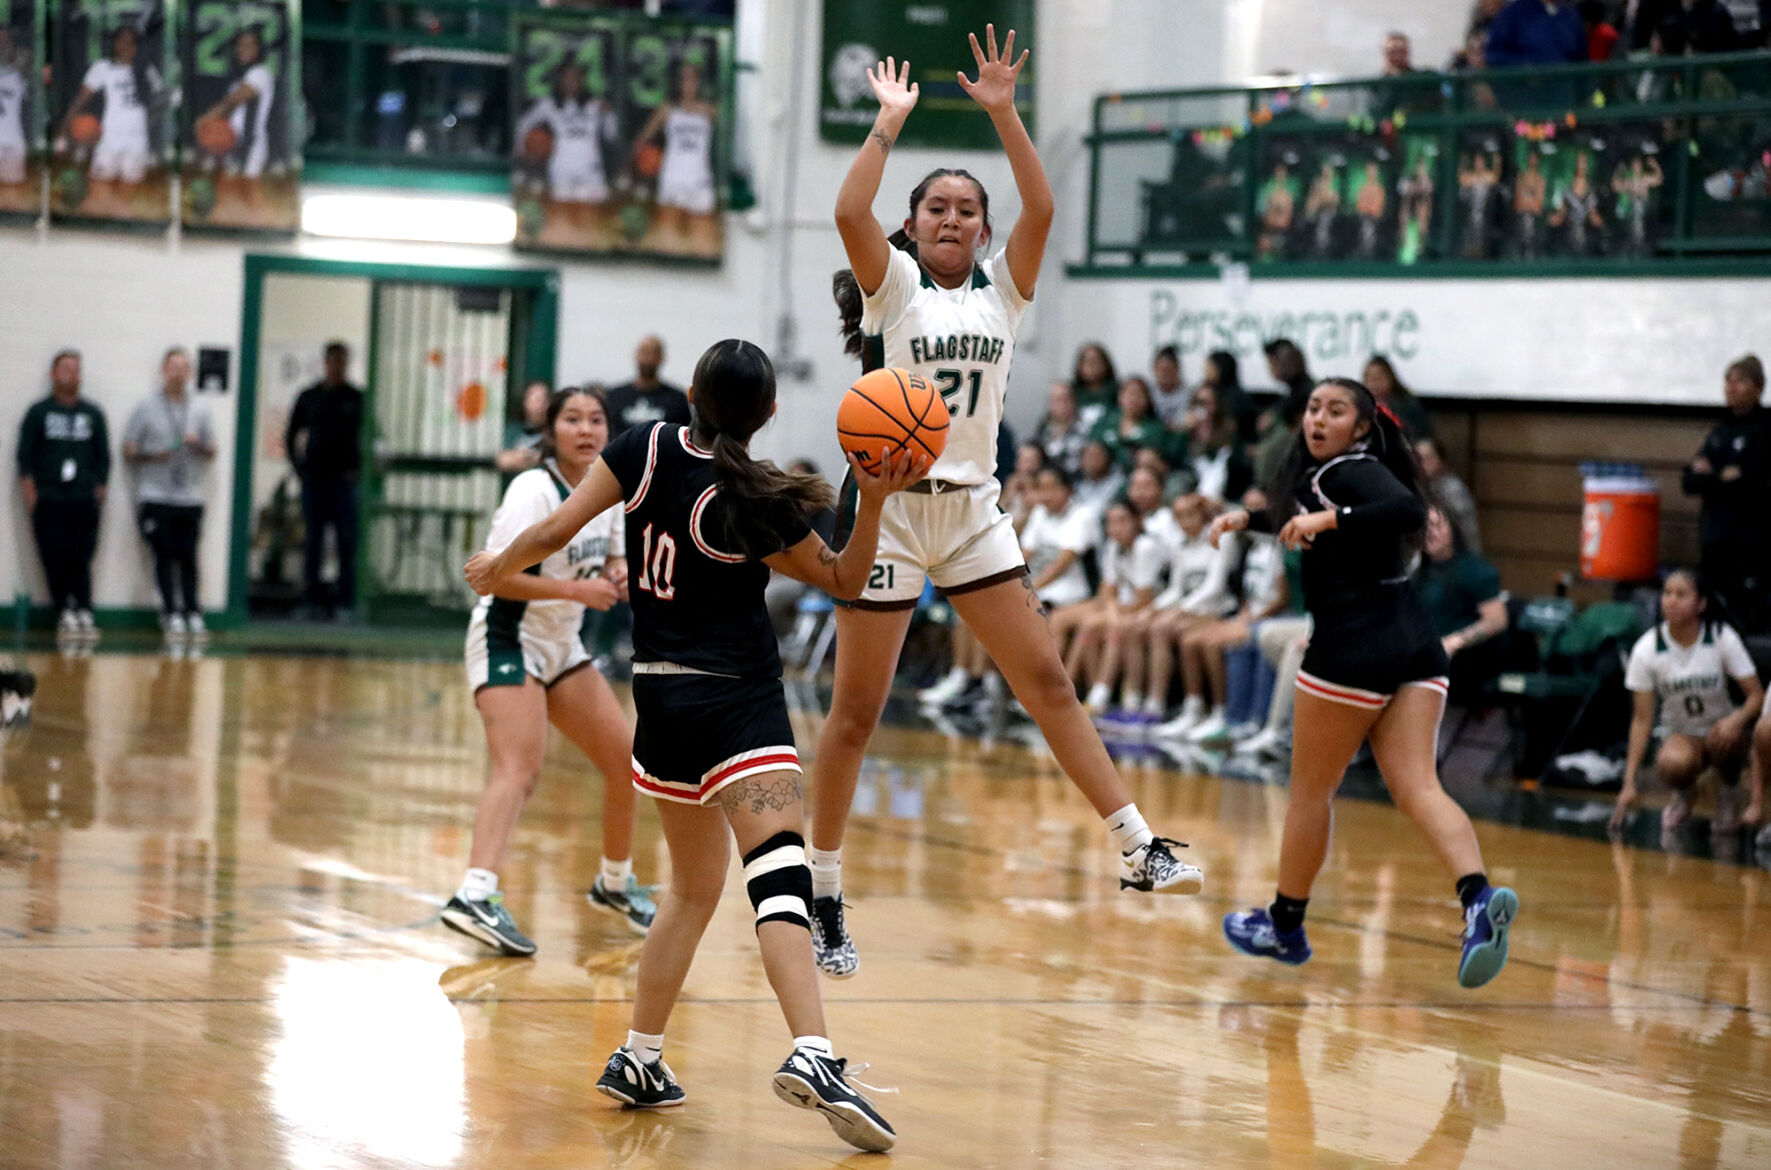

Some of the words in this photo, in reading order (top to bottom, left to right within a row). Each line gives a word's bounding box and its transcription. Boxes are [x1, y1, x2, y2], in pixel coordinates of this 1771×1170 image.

[1151, 289, 1420, 359] Perseverance
[910, 334, 1005, 365] FLAGSTAFF
[933, 368, 984, 418] 21
[638, 521, 676, 601] 10
[868, 563, 895, 590] 21
